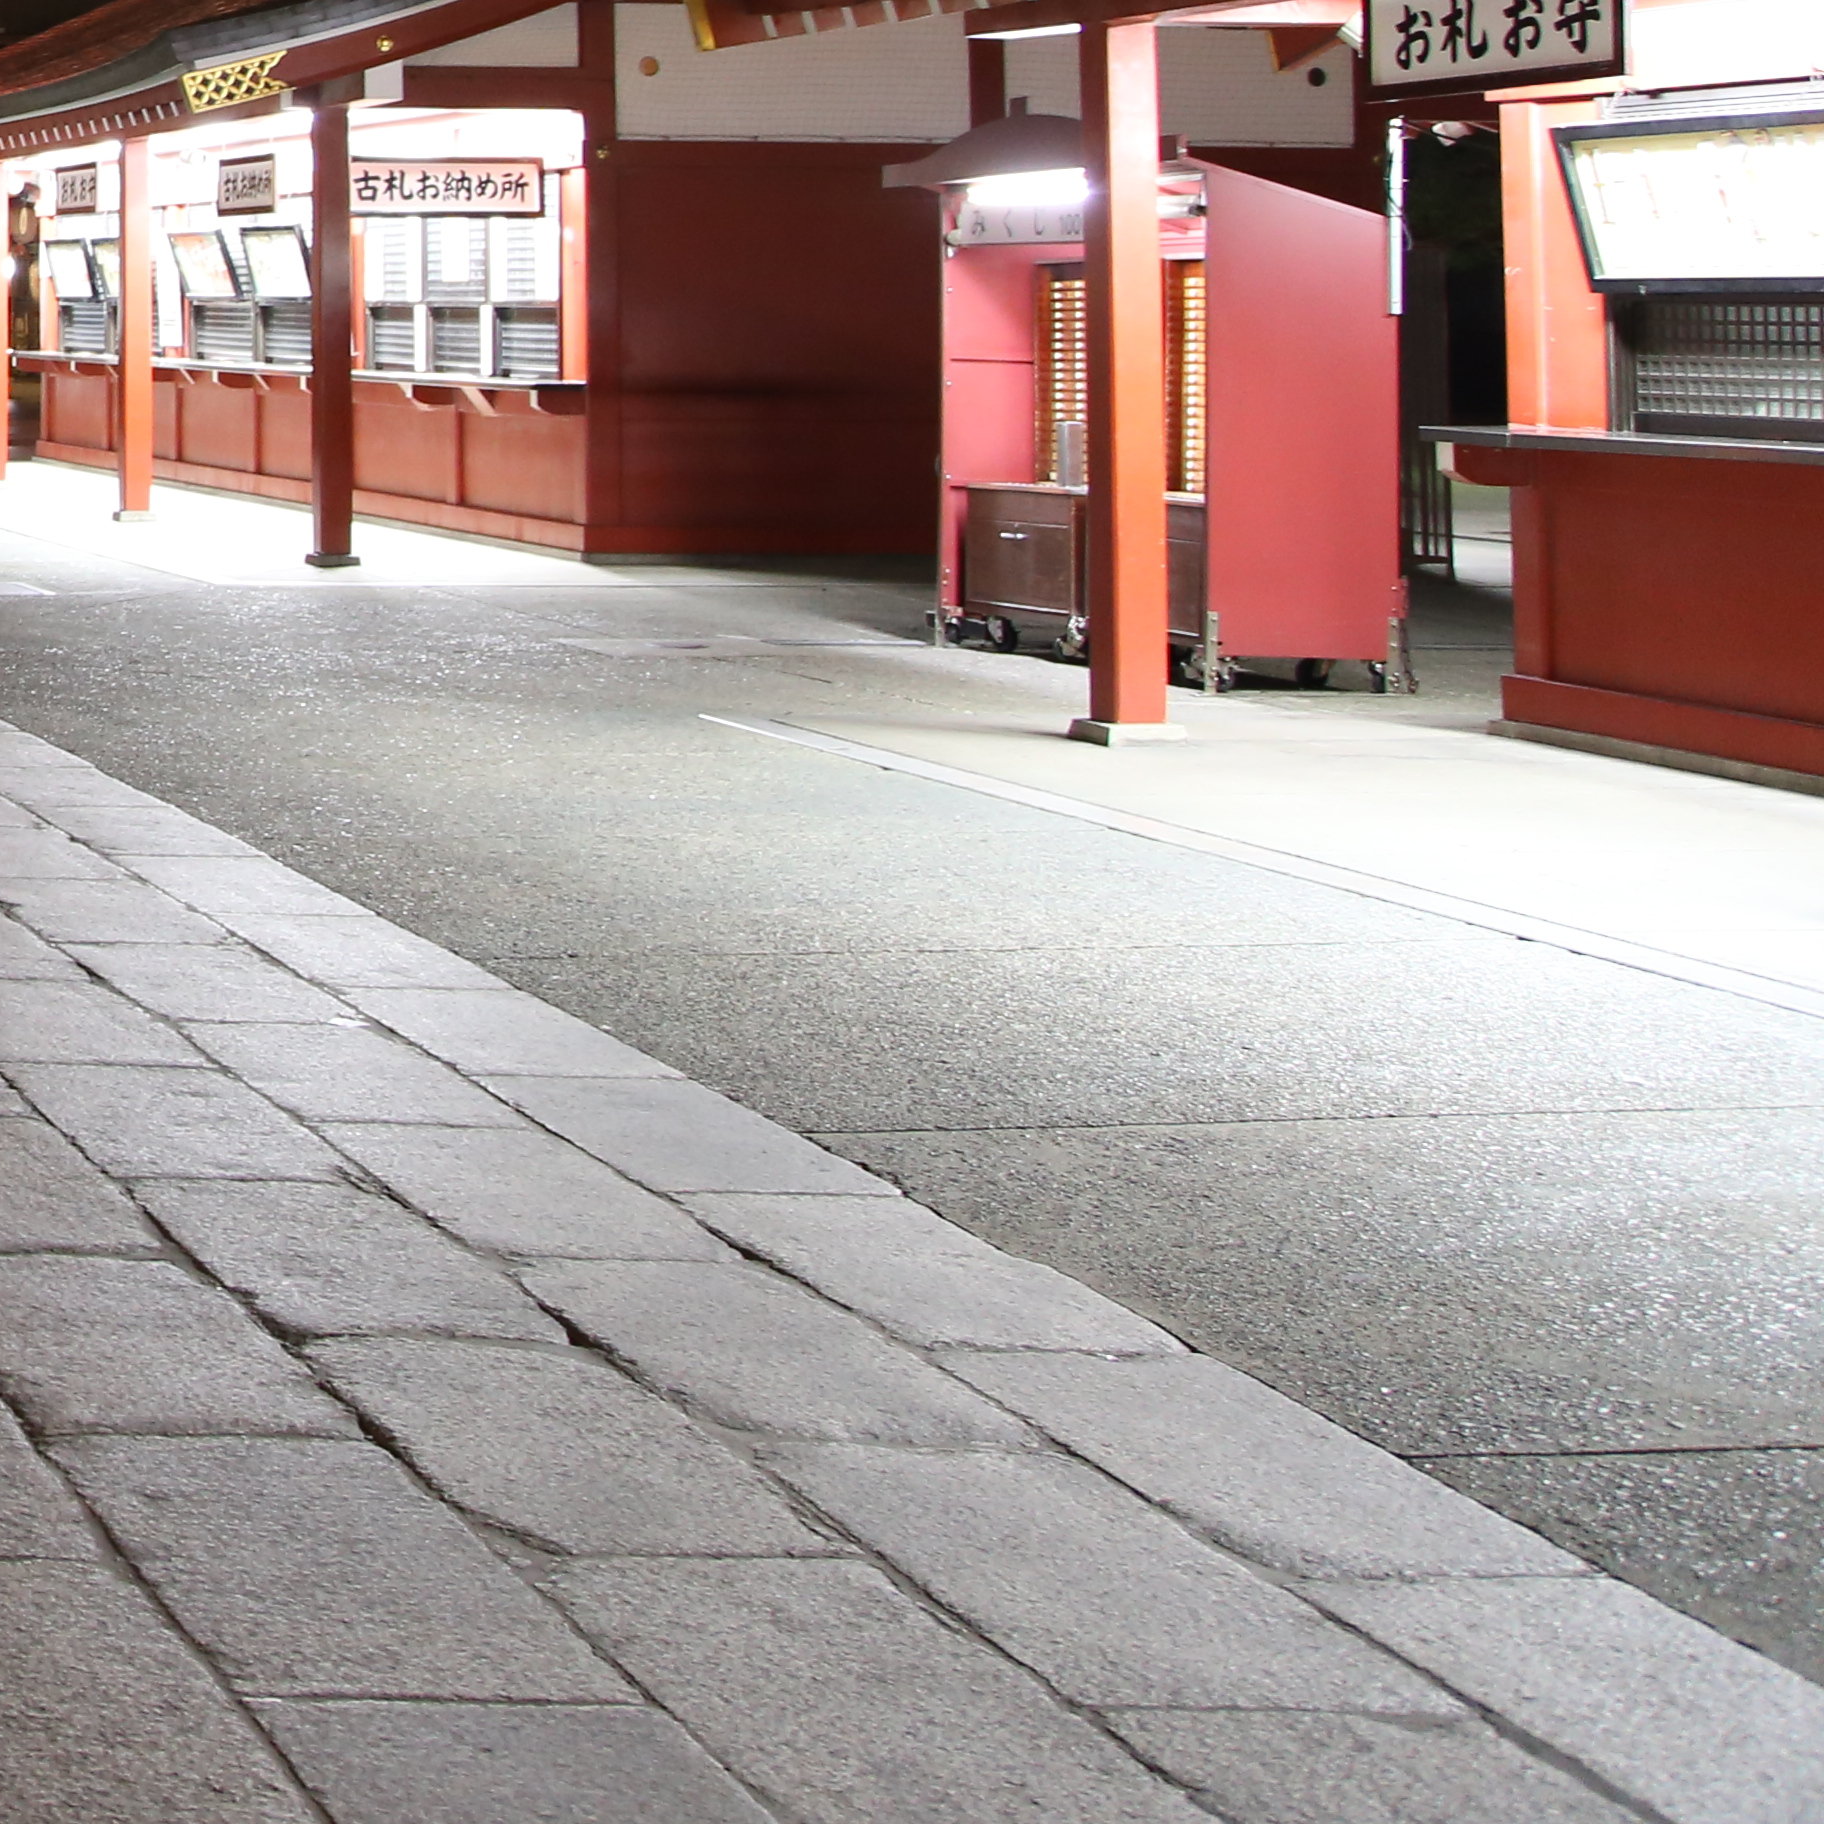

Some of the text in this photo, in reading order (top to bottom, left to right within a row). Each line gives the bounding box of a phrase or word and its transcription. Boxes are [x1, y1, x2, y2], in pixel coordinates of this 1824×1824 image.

[353, 169, 529, 203] 古札お納め所
